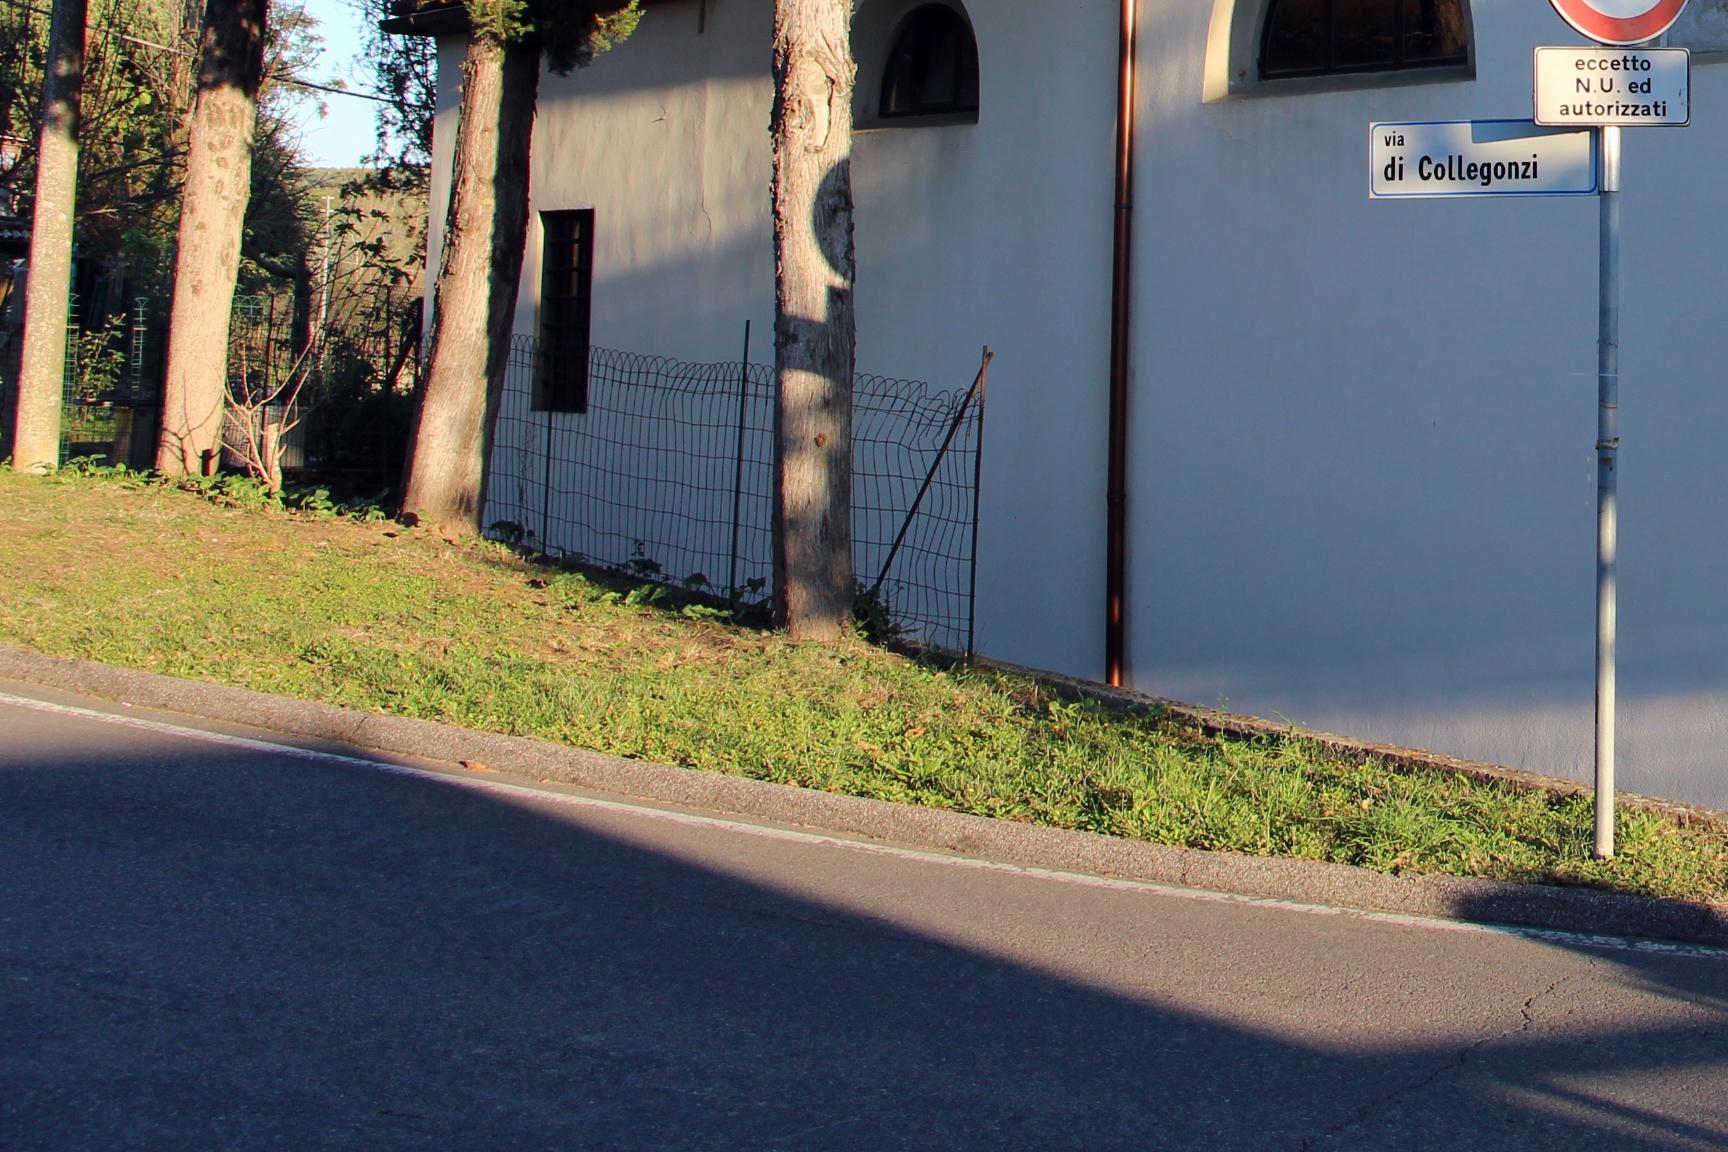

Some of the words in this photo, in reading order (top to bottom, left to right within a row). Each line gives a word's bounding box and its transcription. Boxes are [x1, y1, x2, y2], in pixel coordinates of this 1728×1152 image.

[1575, 55, 1651, 71] eccetto
[1575, 78, 1621, 94] N.U.
[1628, 78, 1652, 94] ed
[1559, 100, 1667, 117] autorizzati
[1384, 131, 1405, 147] via
[1384, 156, 1404, 181] di
[1418, 154, 1538, 186] Collegonzi
